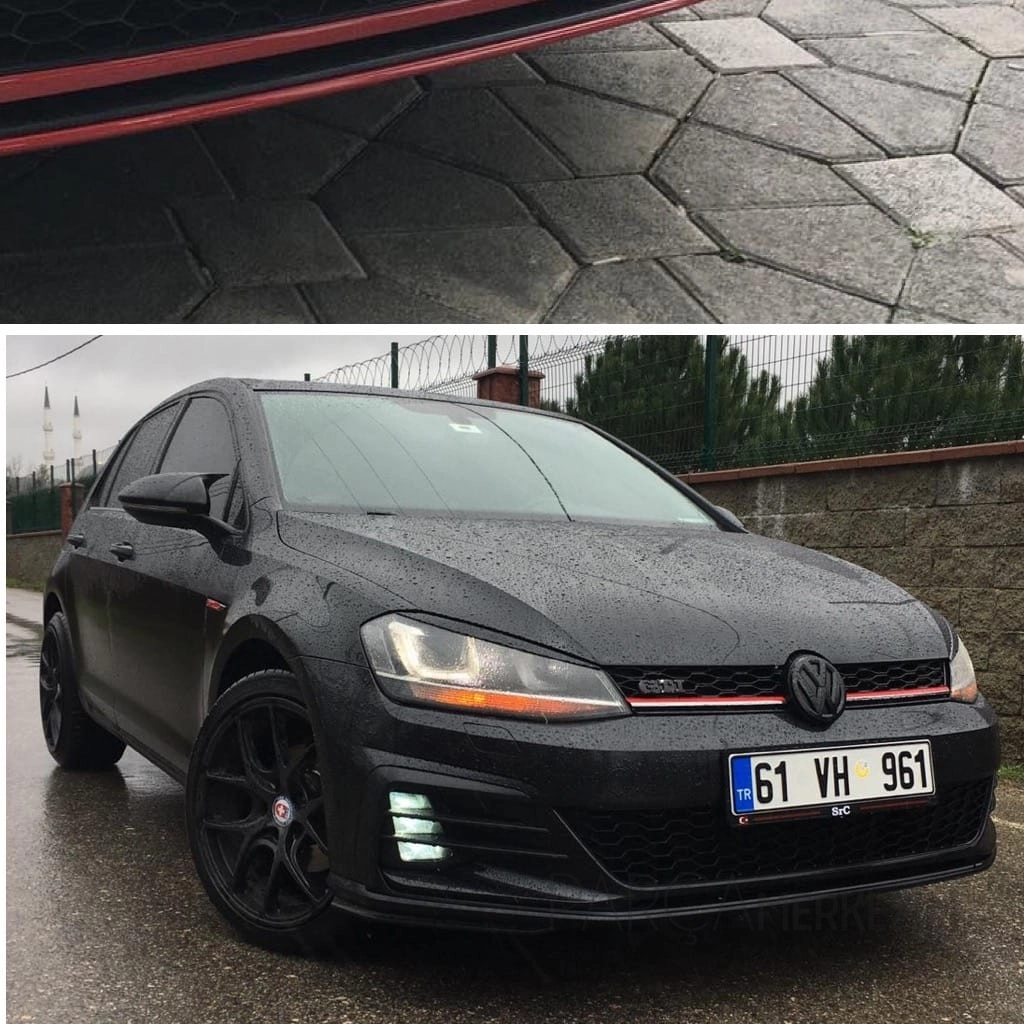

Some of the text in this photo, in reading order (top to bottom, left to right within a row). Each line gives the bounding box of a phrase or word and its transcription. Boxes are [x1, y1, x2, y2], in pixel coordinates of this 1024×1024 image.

[754, 749, 927, 804] 61 VH 961
[736, 788, 752, 801] TR
